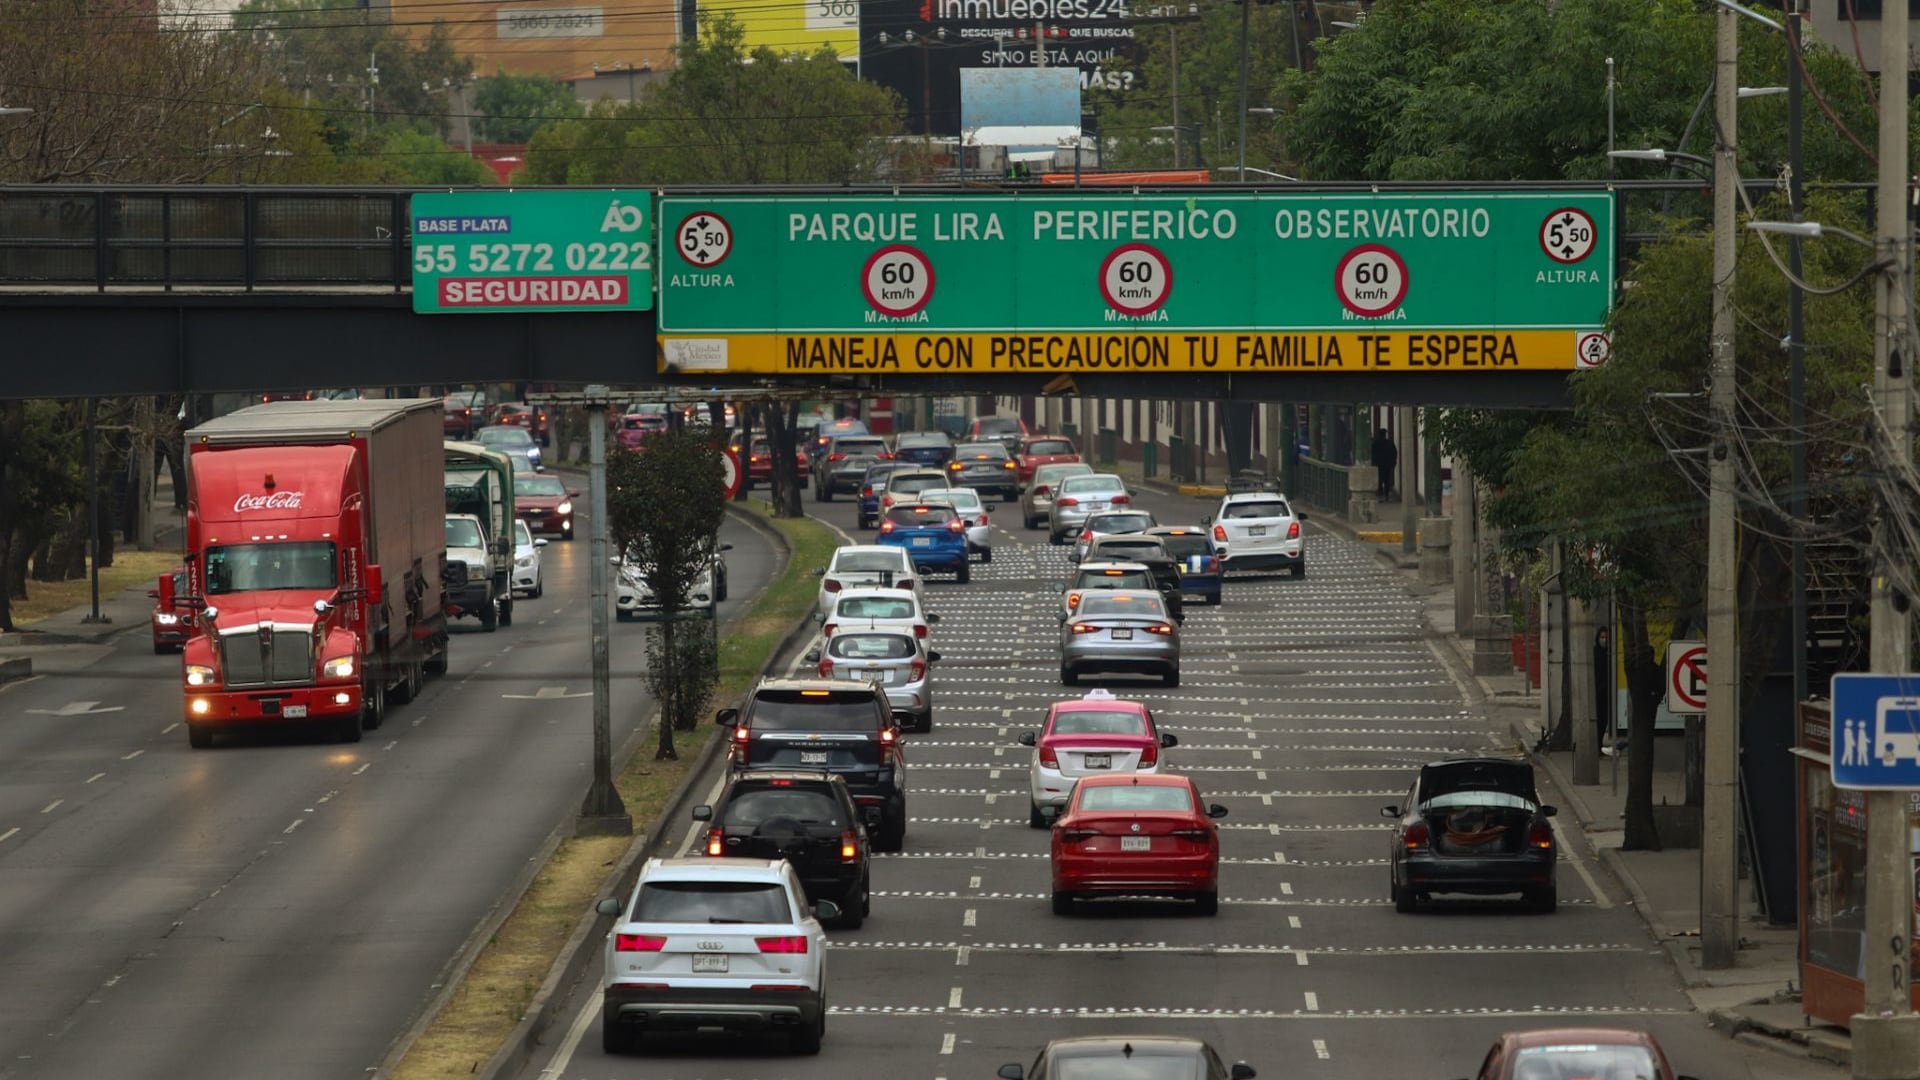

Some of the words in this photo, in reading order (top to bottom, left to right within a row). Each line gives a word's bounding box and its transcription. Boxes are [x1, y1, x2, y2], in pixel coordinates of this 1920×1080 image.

[1069, 28, 1091, 38] QUE
[1093, 28, 1135, 38] BUSCAS
[1073, 47, 1114, 64] AQUÍ
[418, 219, 457, 231] BASE
[462, 219, 509, 231] PLATA
[789, 212, 917, 242] PARQUE
[934, 211, 1004, 241] LIRA
[1033, 208, 1238, 240] PERIFERICO
[1275, 207, 1490, 238] OBSERVATORIO
[684, 228, 698, 251] 5
[704, 232, 724, 247] 50
[1549, 224, 1563, 247] 5
[1569, 227, 1590, 242] 50
[414, 244, 457, 273] 55
[469, 243, 554, 272] 5272
[565, 241, 650, 271] 0222
[670, 274, 735, 287] ALTURA
[880, 262, 915, 285] 60
[1118, 261, 1153, 284] 60
[1354, 261, 1389, 284] 60
[1535, 270, 1600, 283] ALTURA
[445, 280, 622, 302] SEGURIDAD
[881, 287, 915, 301] km/h
[1118, 286, 1152, 300] km/h
[1354, 286, 1388, 300] km/h
[1342, 308, 1407, 321] MMA
[785, 337, 900, 369] MANEJA
[915, 337, 974, 369] CON
[990, 336, 1170, 369] PRECAUCION
[1183, 336, 1220, 367] TU
[1236, 336, 1343, 367] FAMILIA
[1357, 336, 1392, 367] TE
[1408, 335, 1519, 367] ESPERA
[234, 491, 304, 513] Coca-Cola
